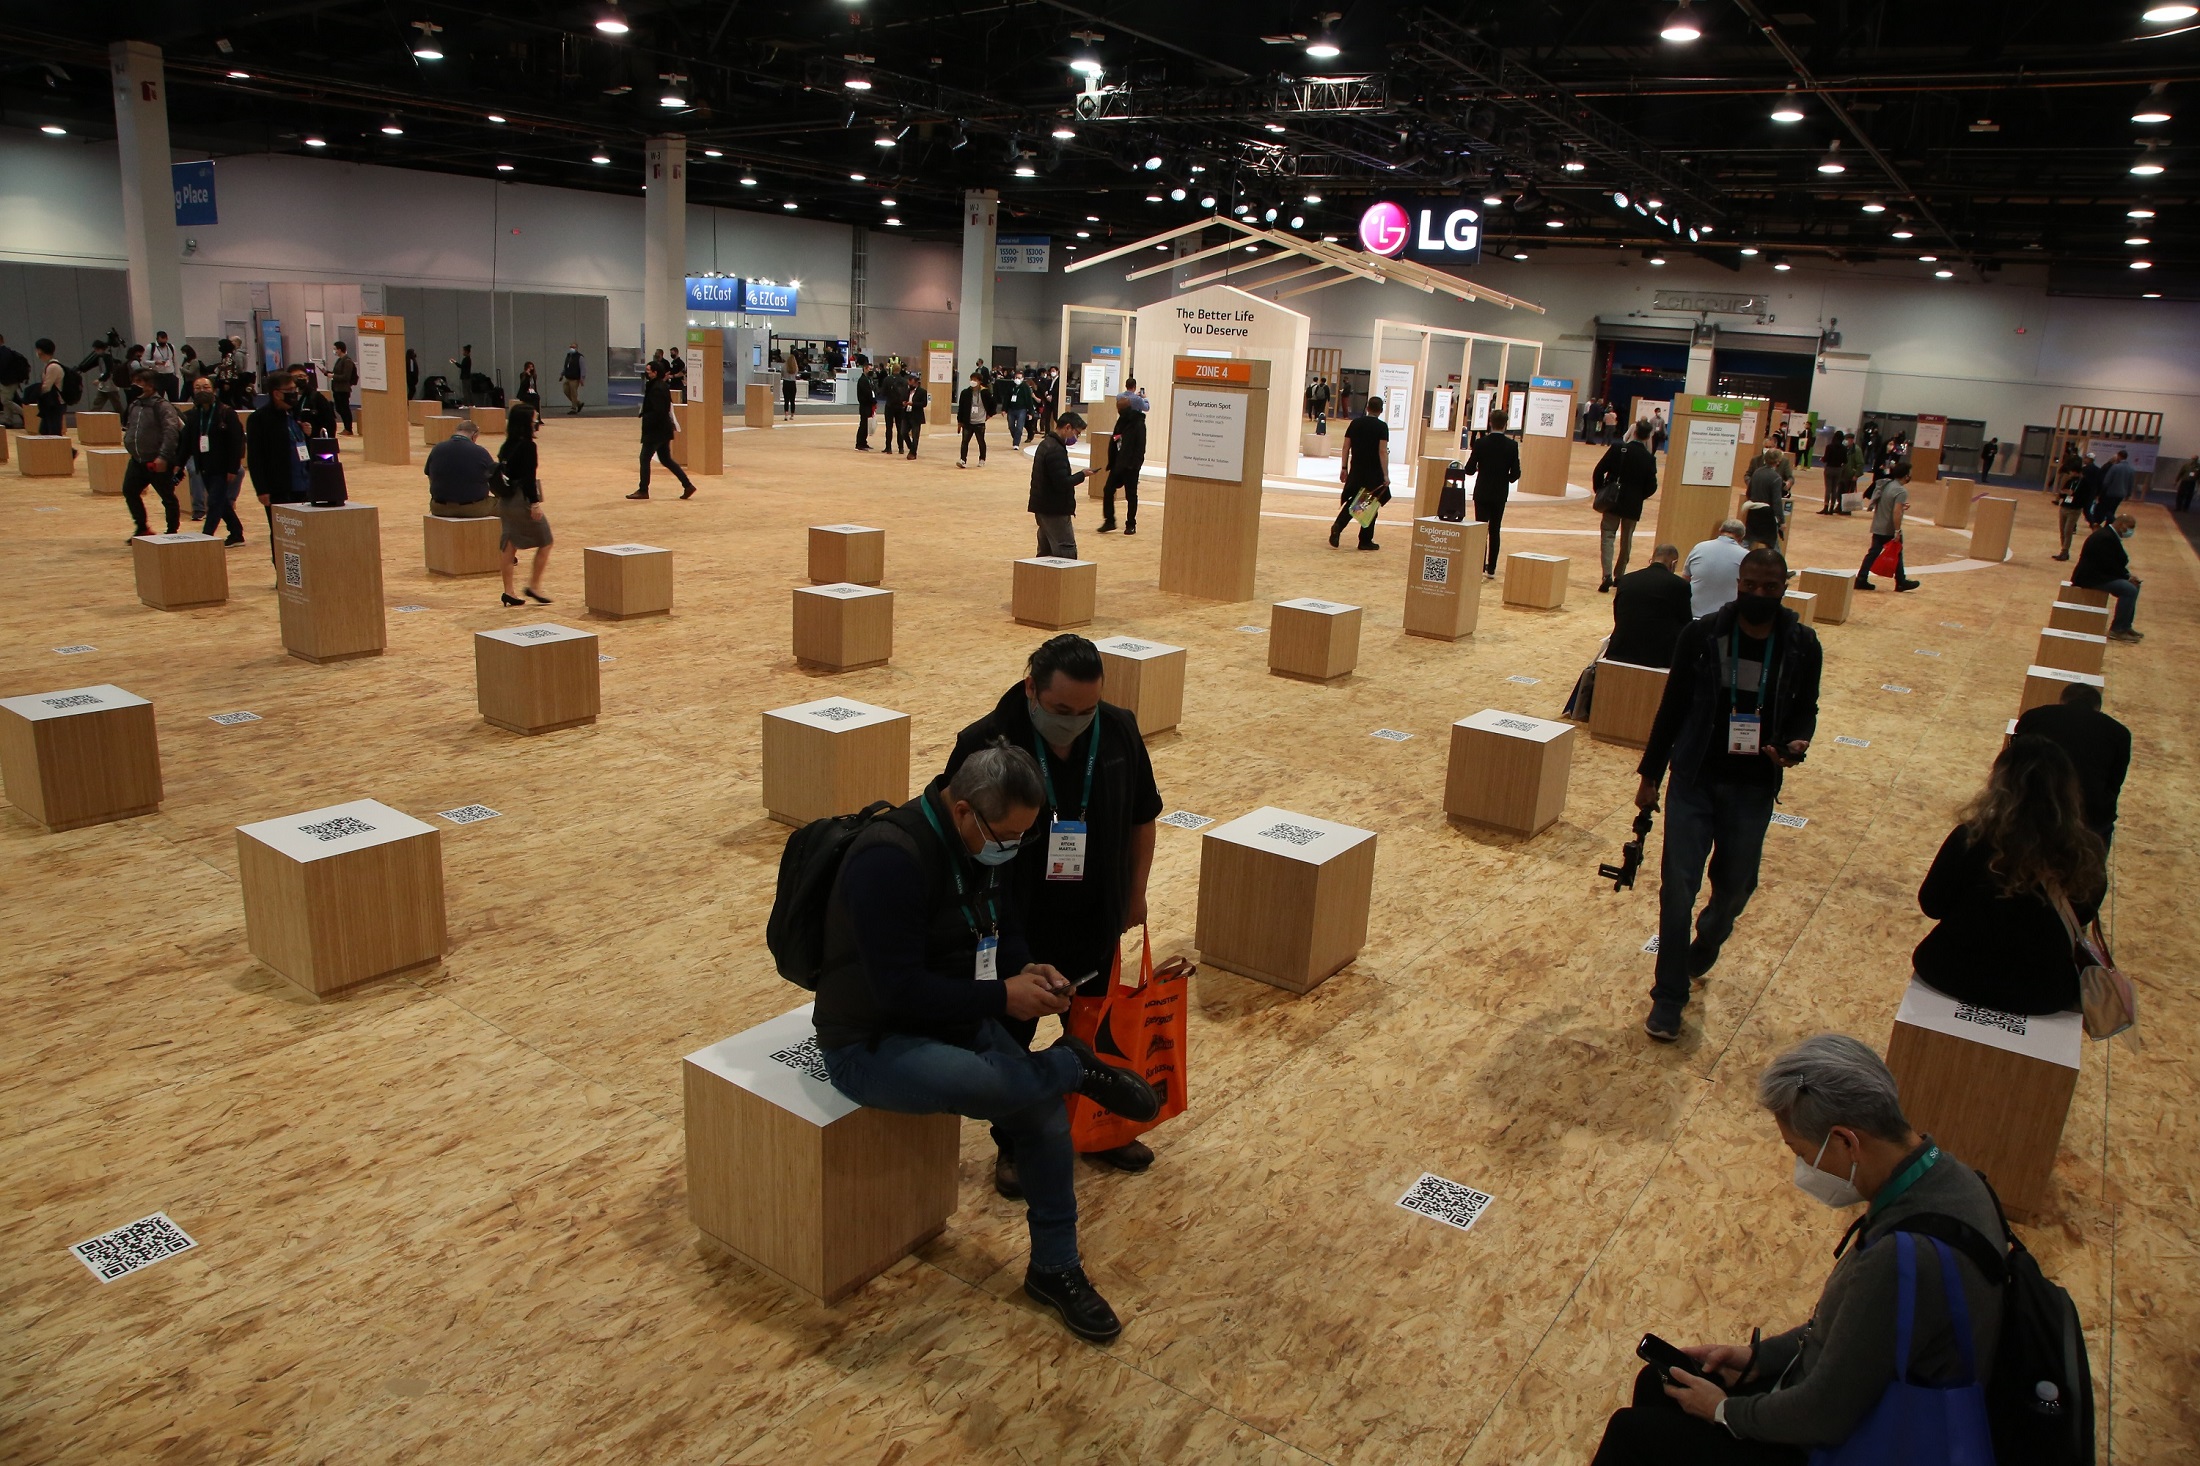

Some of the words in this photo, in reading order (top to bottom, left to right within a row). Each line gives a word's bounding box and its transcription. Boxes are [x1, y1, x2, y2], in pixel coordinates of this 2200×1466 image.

[183, 184, 209, 204] Place
[1418, 209, 1479, 251] LG
[704, 285, 732, 301] EZCast
[759, 291, 788, 307] EZCast
[1176, 308, 1195, 319] The
[1198, 308, 1232, 321] Better
[1235, 310, 1254, 322] Life
[1183, 323, 1202, 334] You
[1206, 324, 1249, 337] Deserve
[1196, 365, 1219, 377] ZONE
[1222, 367, 1228, 378] 4
[1542, 379, 1556, 387] ZONE
[1556, 380, 1561, 388] 3
[1188, 400, 1218, 408] Exploration
[1218, 402, 1231, 410] Spot
[1707, 402, 1723, 411] ZONE
[1724, 403, 1729, 412] 2
[1420, 525, 1460, 538] Exploration
[1430, 534, 1448, 544] Spot
[1144, 994, 1179, 1009] MONSTER
